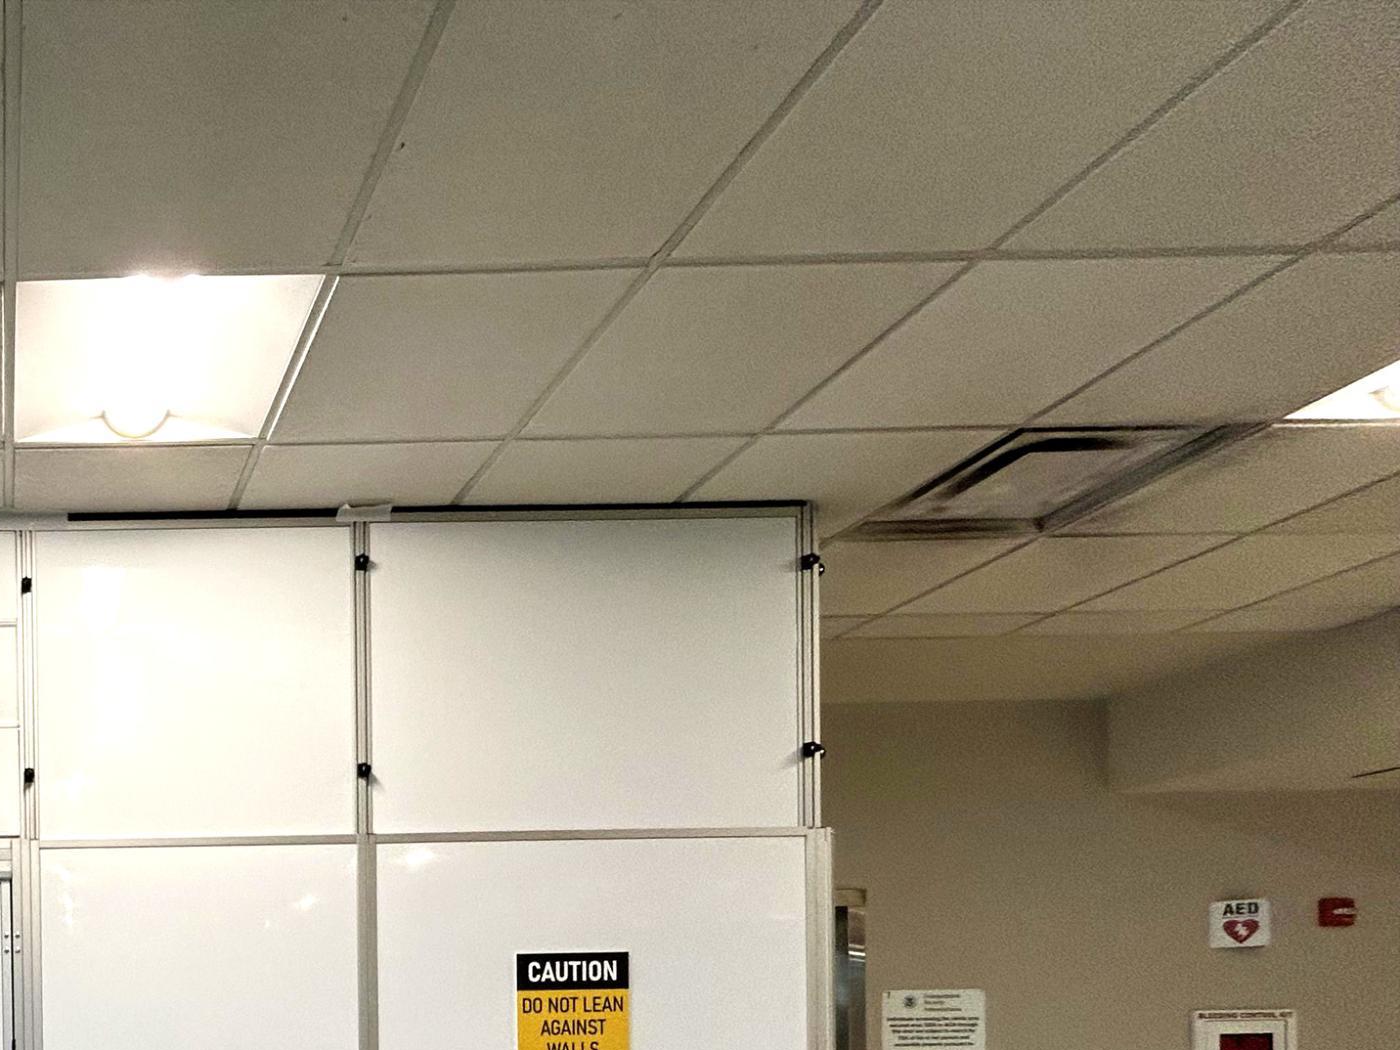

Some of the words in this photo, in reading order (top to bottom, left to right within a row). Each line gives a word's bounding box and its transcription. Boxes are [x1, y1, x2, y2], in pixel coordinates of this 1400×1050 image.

[1223, 902, 1259, 916] AED
[528, 960, 618, 982] CAUTION
[522, 997, 543, 1014] DO
[548, 996, 578, 1013] NOT
[583, 996, 624, 1012] LEAN
[540, 1019, 607, 1036] AGAINST
